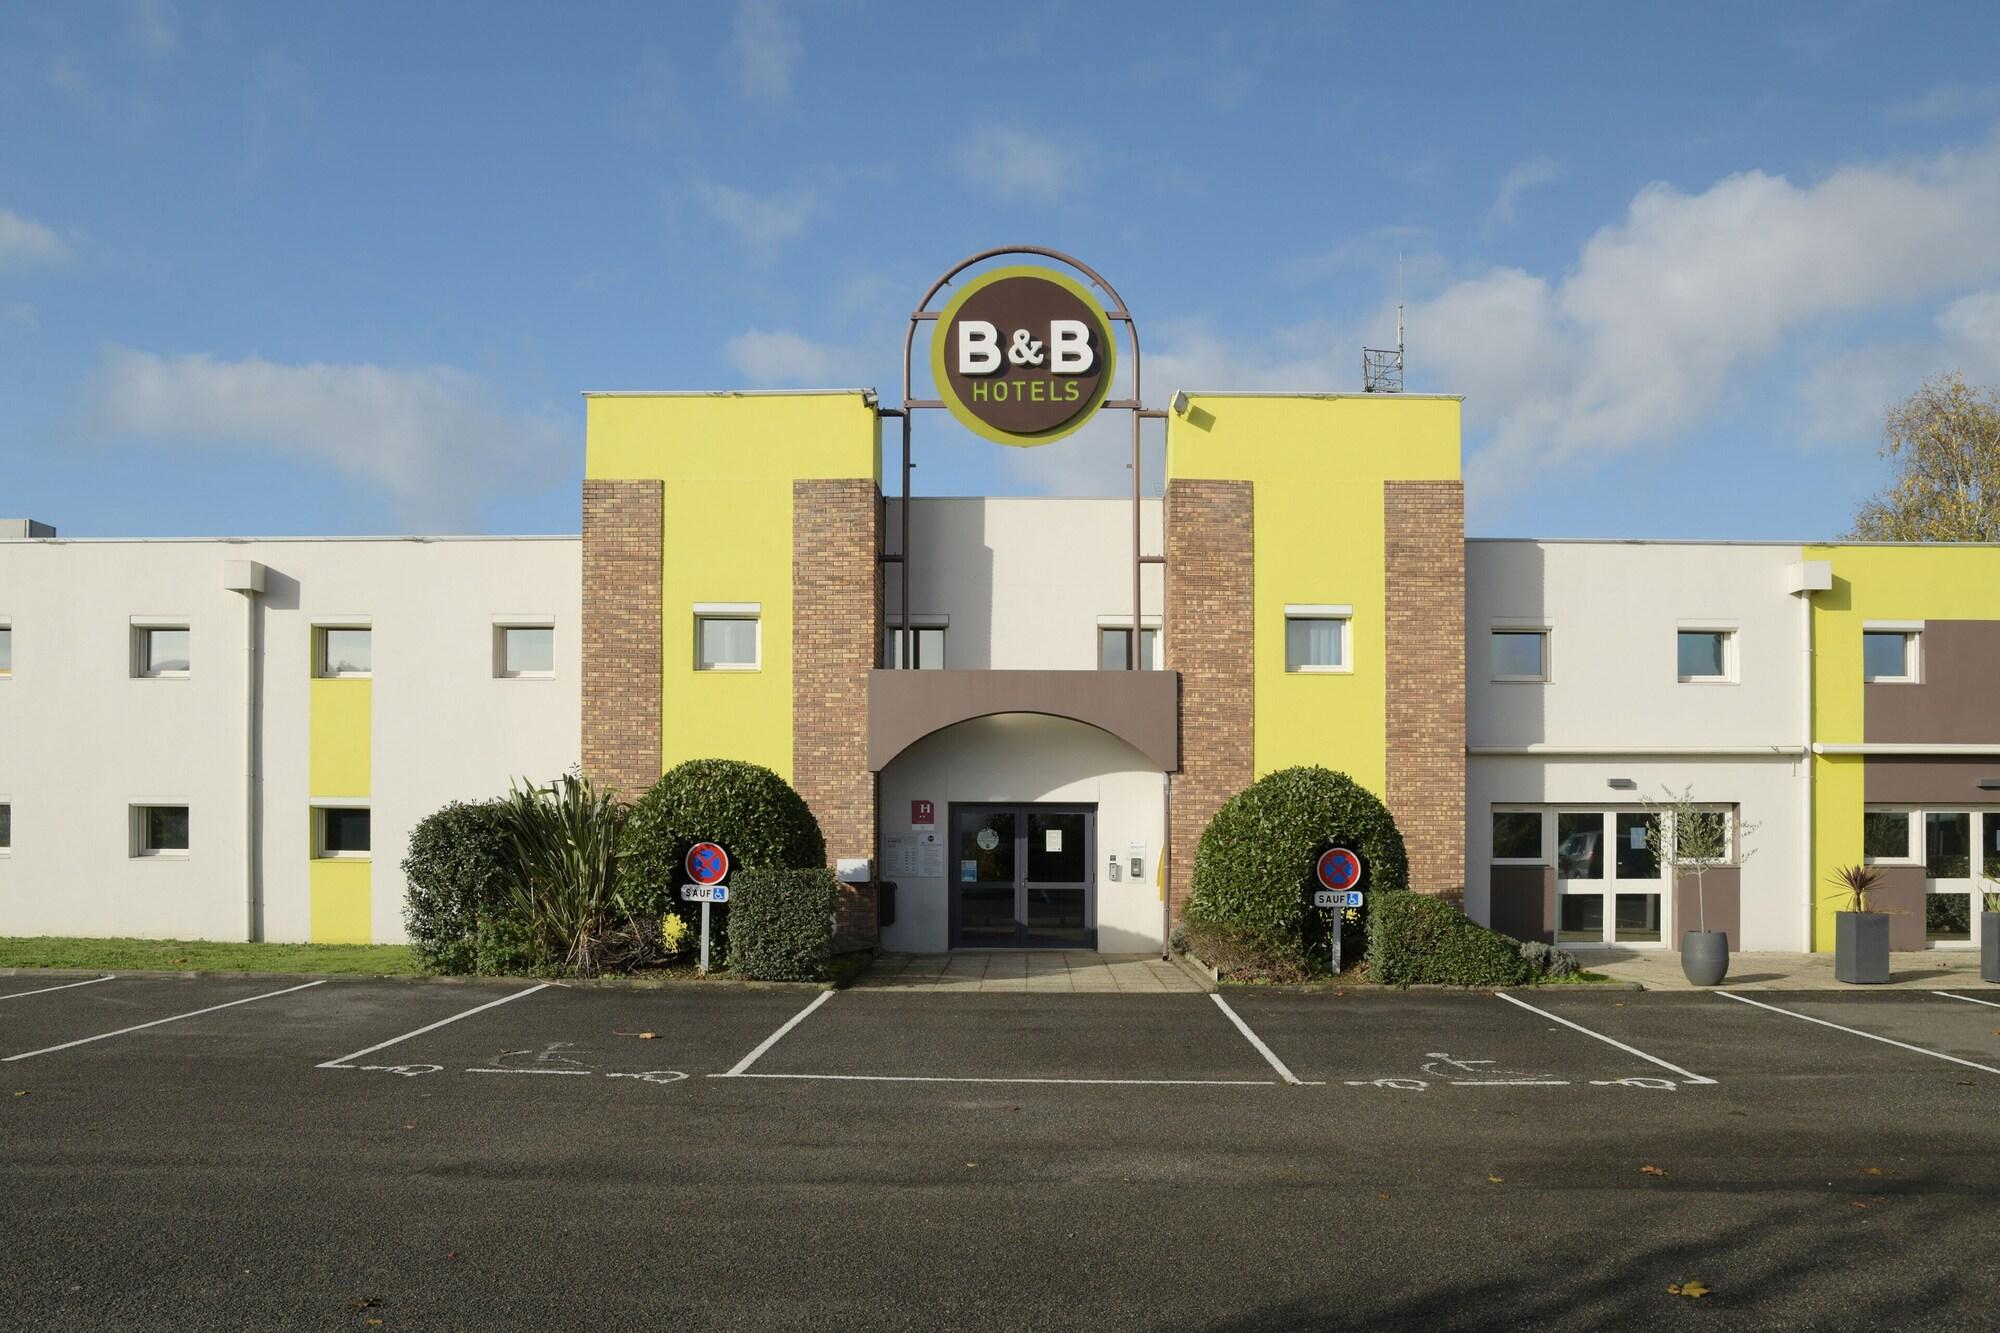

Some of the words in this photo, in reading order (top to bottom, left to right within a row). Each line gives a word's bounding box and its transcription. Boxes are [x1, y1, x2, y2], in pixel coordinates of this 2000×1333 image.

[958, 319, 1094, 375] B&B
[972, 381, 1080, 402] HOTELS
[920, 803, 931, 814] H
[685, 888, 712, 898] SAUF
[1318, 895, 1345, 904] SAUF
